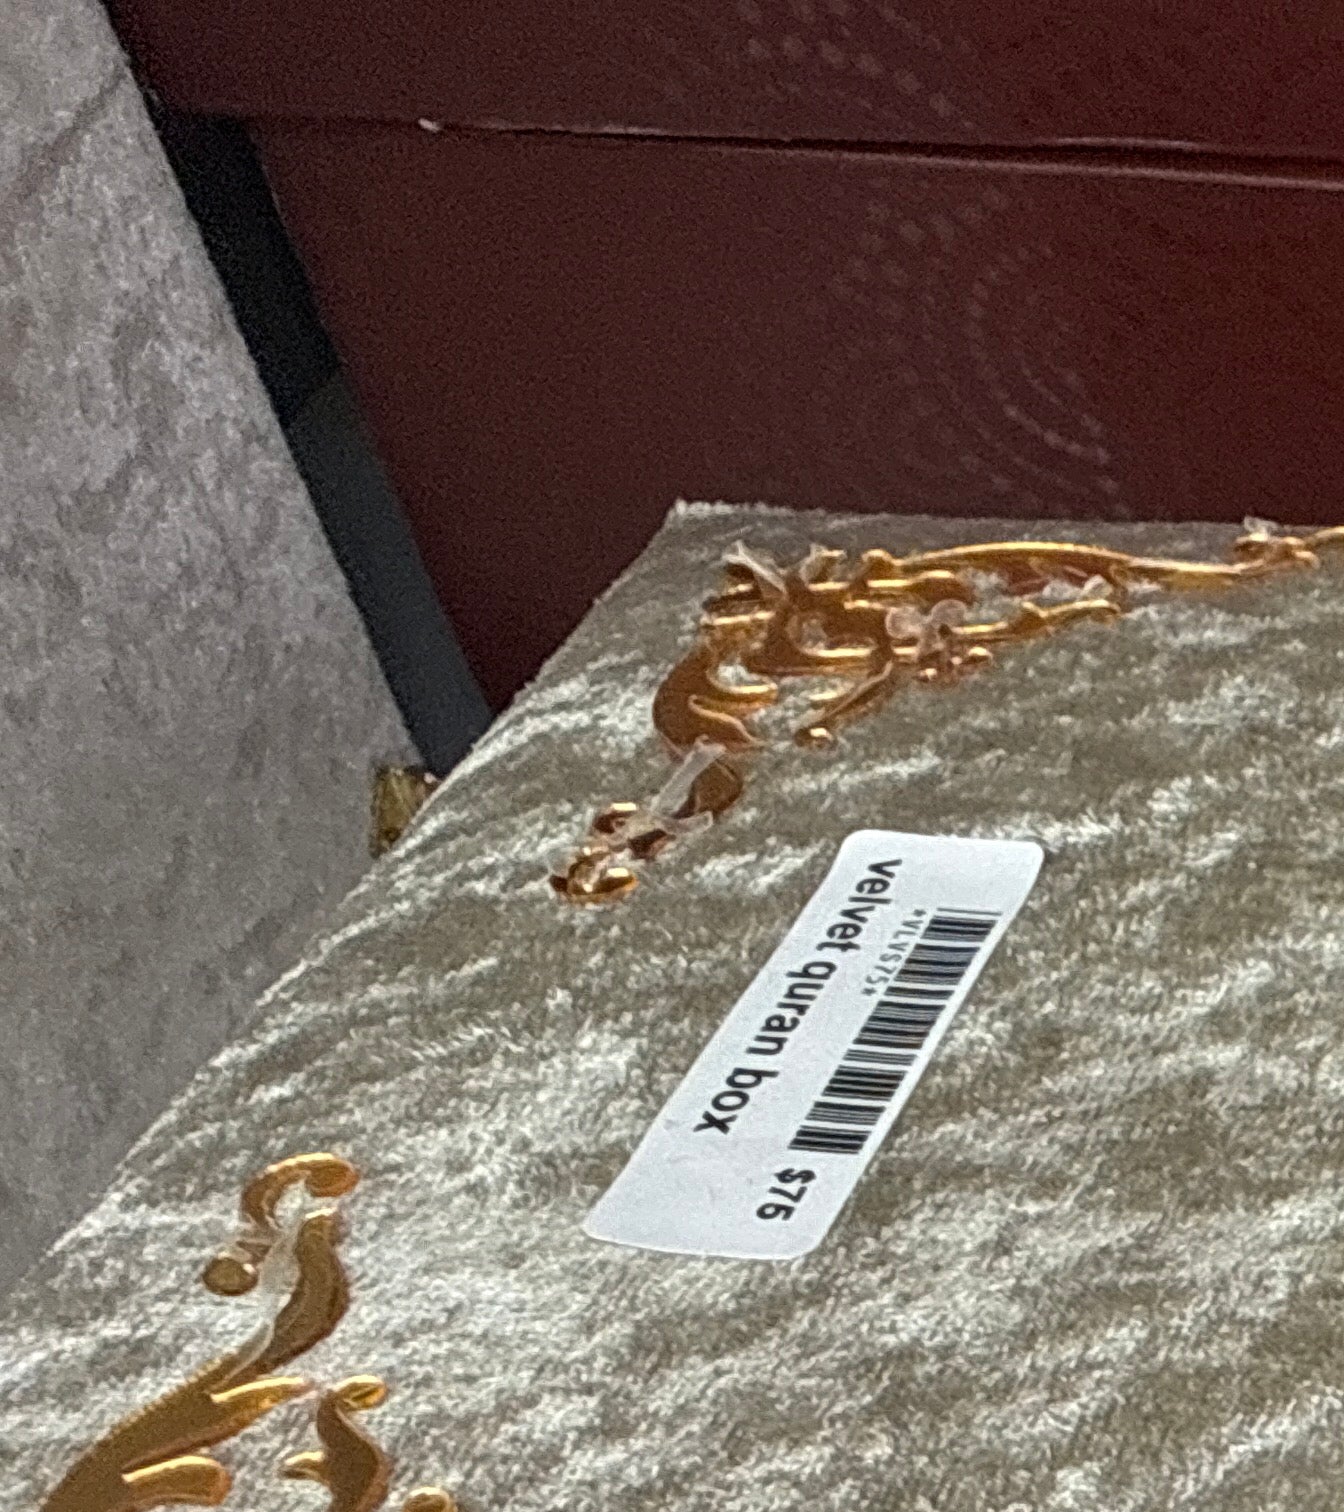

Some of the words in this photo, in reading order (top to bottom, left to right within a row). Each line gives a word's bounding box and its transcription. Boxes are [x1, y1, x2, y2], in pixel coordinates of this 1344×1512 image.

[816, 858, 903, 951] velvet
[745, 960, 837, 1057] quran
[692, 1066, 780, 1136] box
